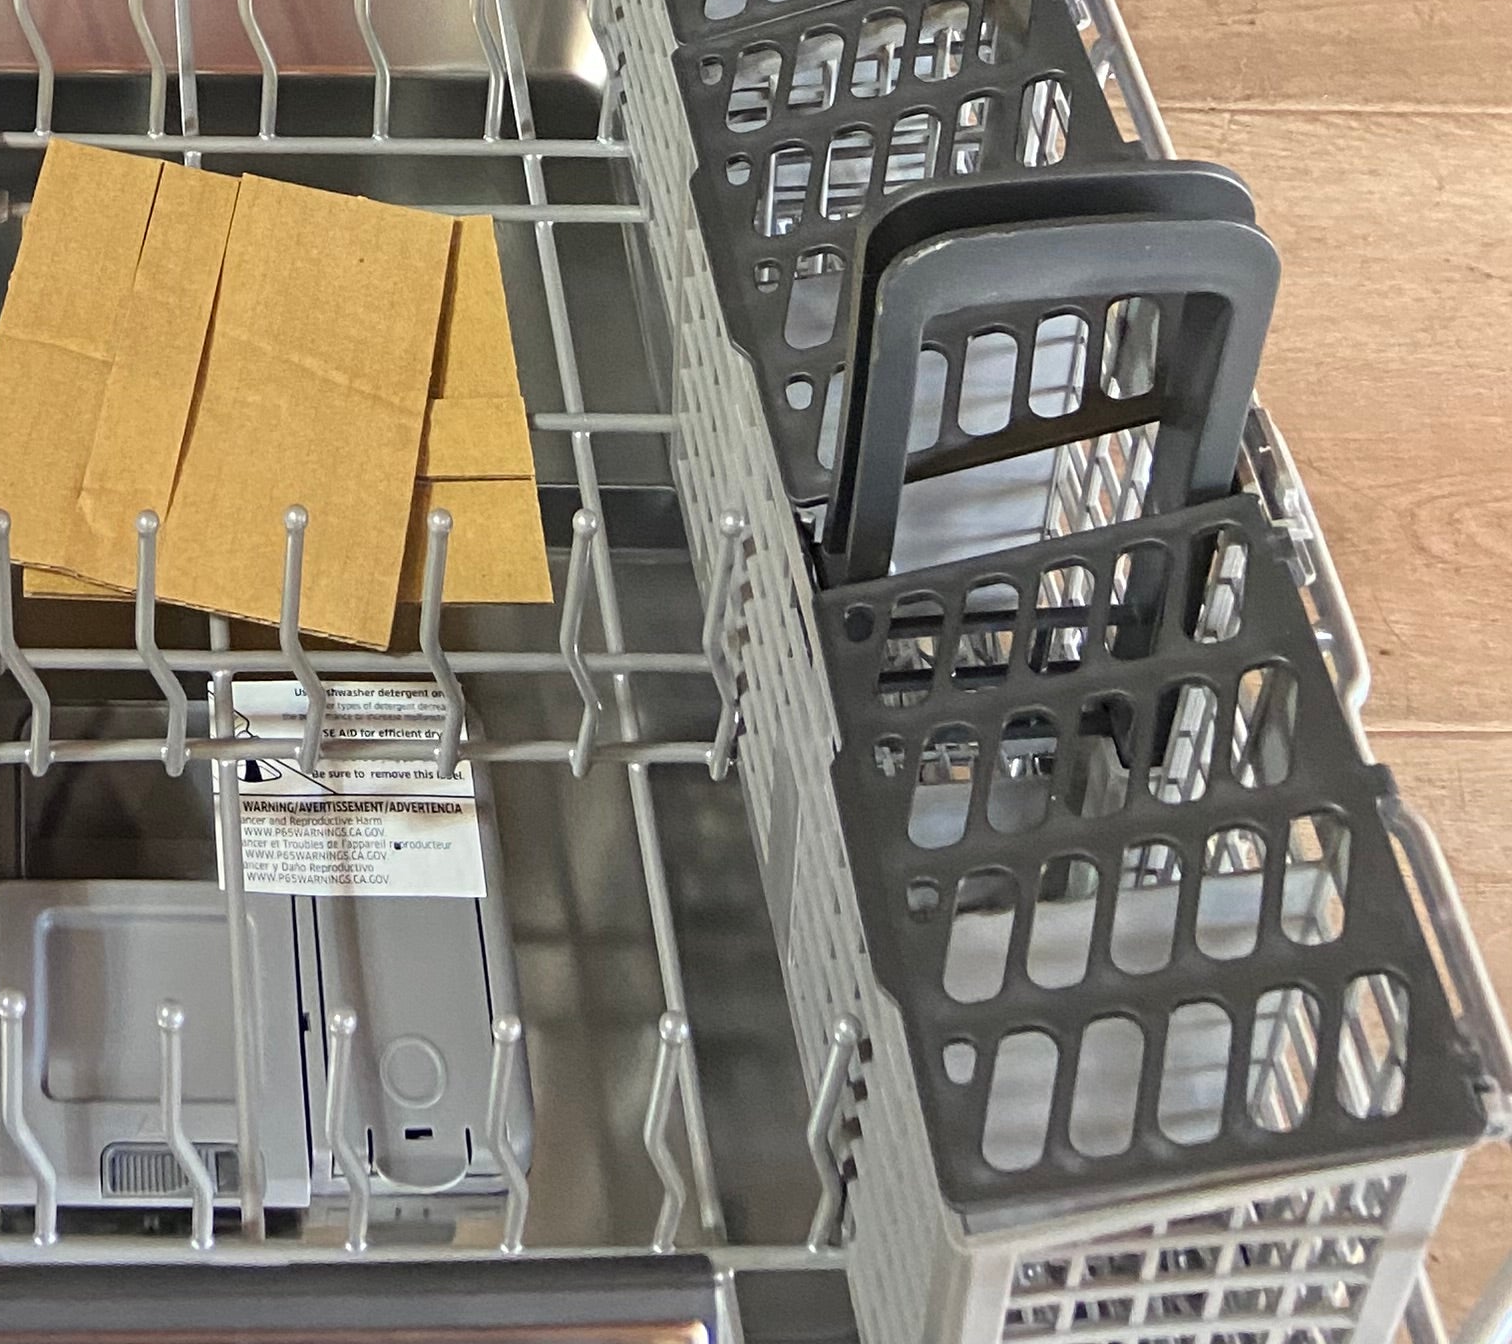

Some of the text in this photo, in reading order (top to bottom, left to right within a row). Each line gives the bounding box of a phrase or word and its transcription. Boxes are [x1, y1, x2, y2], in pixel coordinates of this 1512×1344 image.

[378, 689, 428, 699] detergent
[339, 729, 358, 738] AID
[360, 729, 376, 738] for
[378, 729, 421, 739] efficient
[328, 770, 351, 779] sure
[354, 769, 365, 779] to
[370, 771, 411, 780] remove
[413, 769, 434, 780] this
[268, 816, 287, 825] and
[289, 816, 353, 828] Reproductive
[356, 817, 383, 826] Harm
[309, 863, 374, 873] Reproductivo
